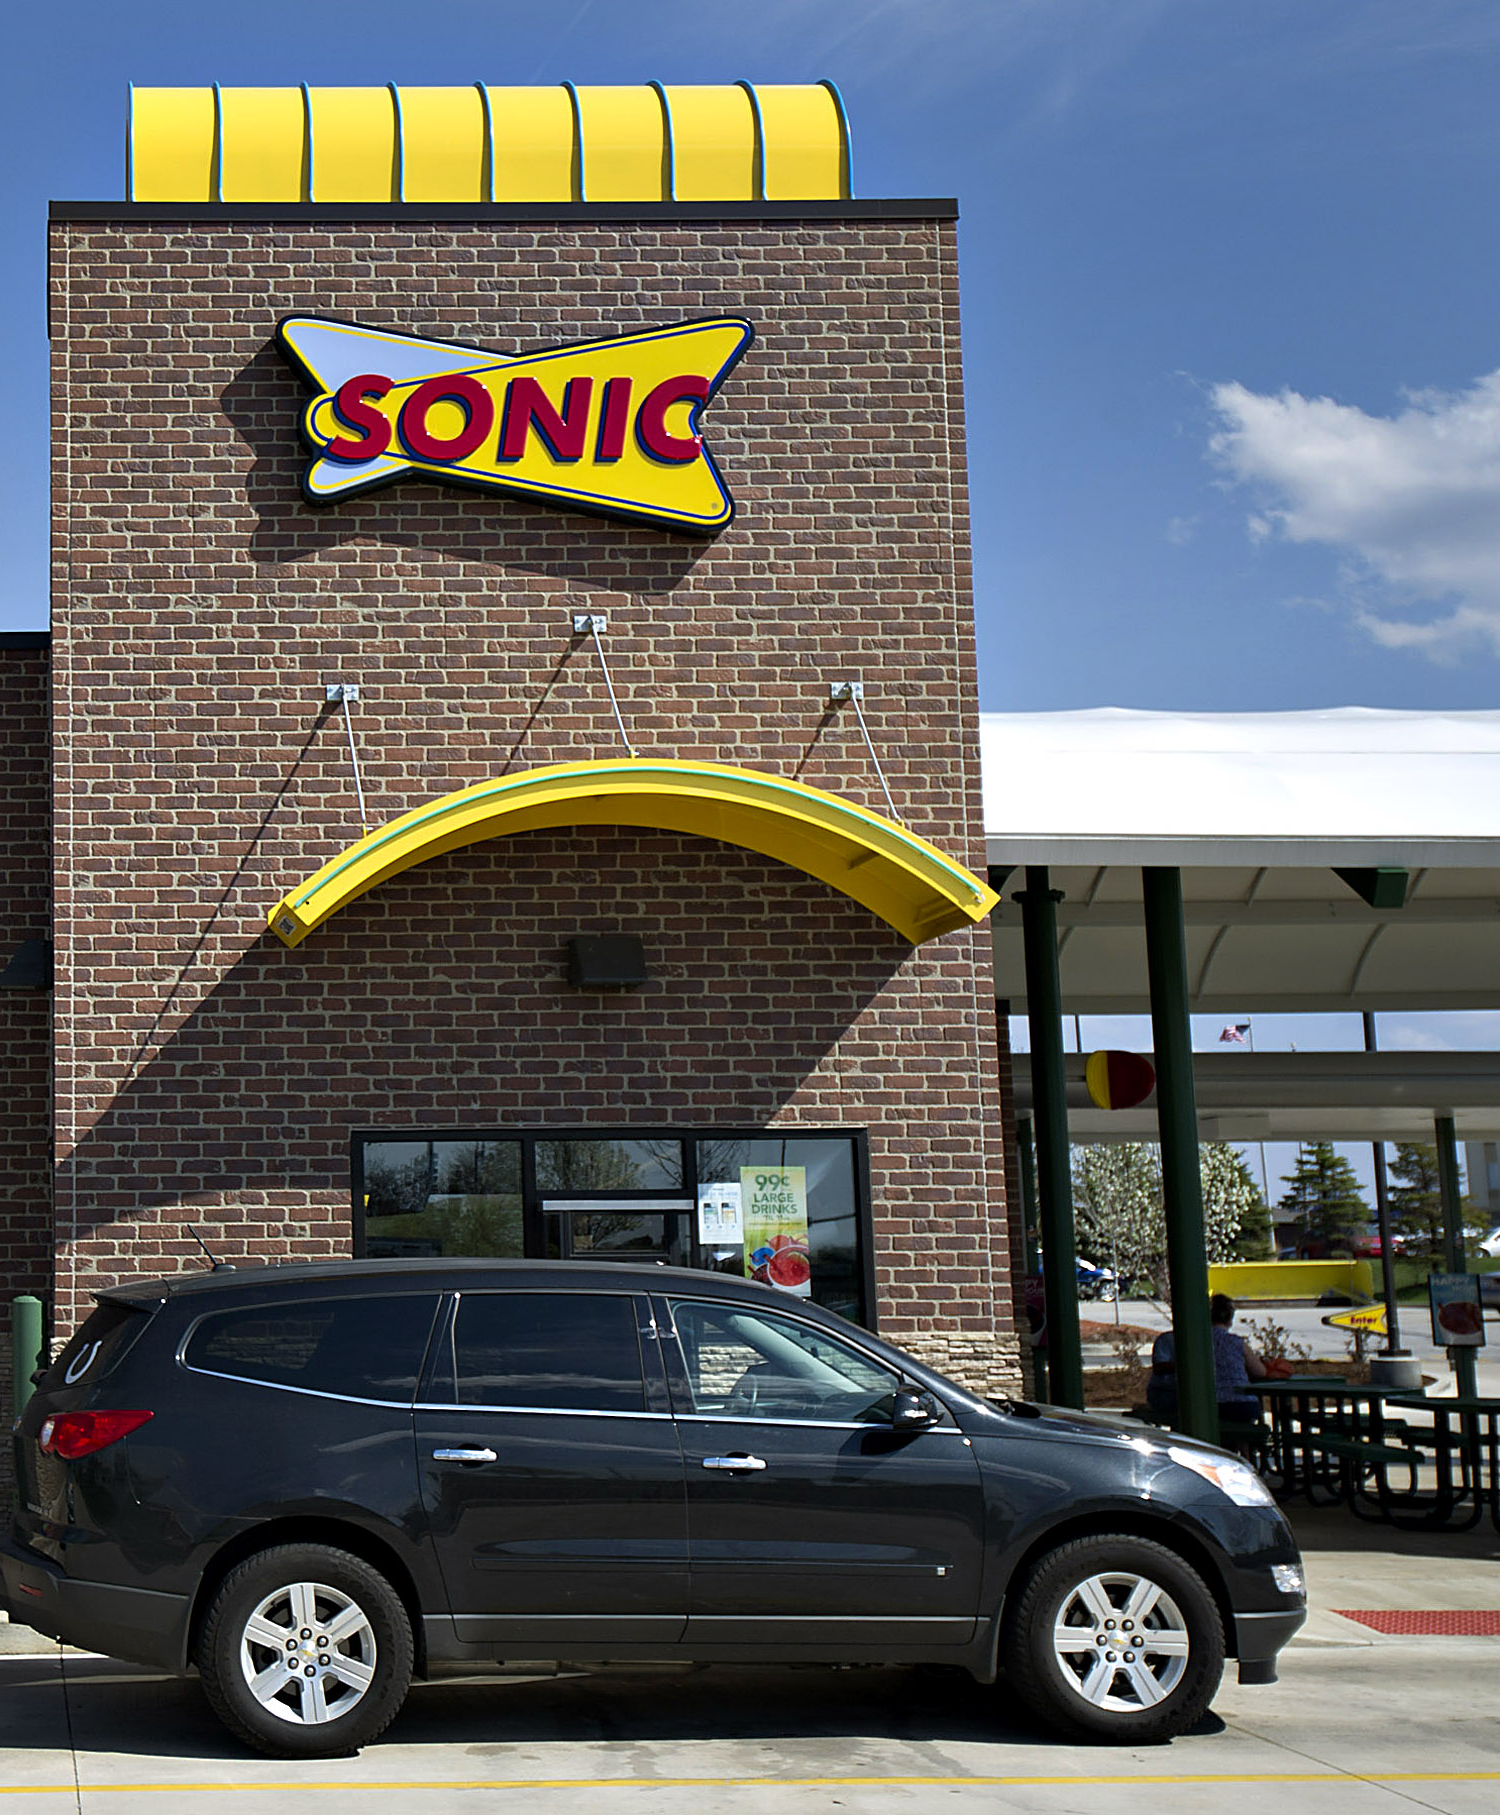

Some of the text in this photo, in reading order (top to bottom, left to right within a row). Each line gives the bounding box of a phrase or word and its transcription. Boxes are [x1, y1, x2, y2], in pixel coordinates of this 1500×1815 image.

[324, 374, 711, 464] SONIC
[753, 1192, 794, 1203] LARGE
[751, 1203, 798, 1214] DRINKS
